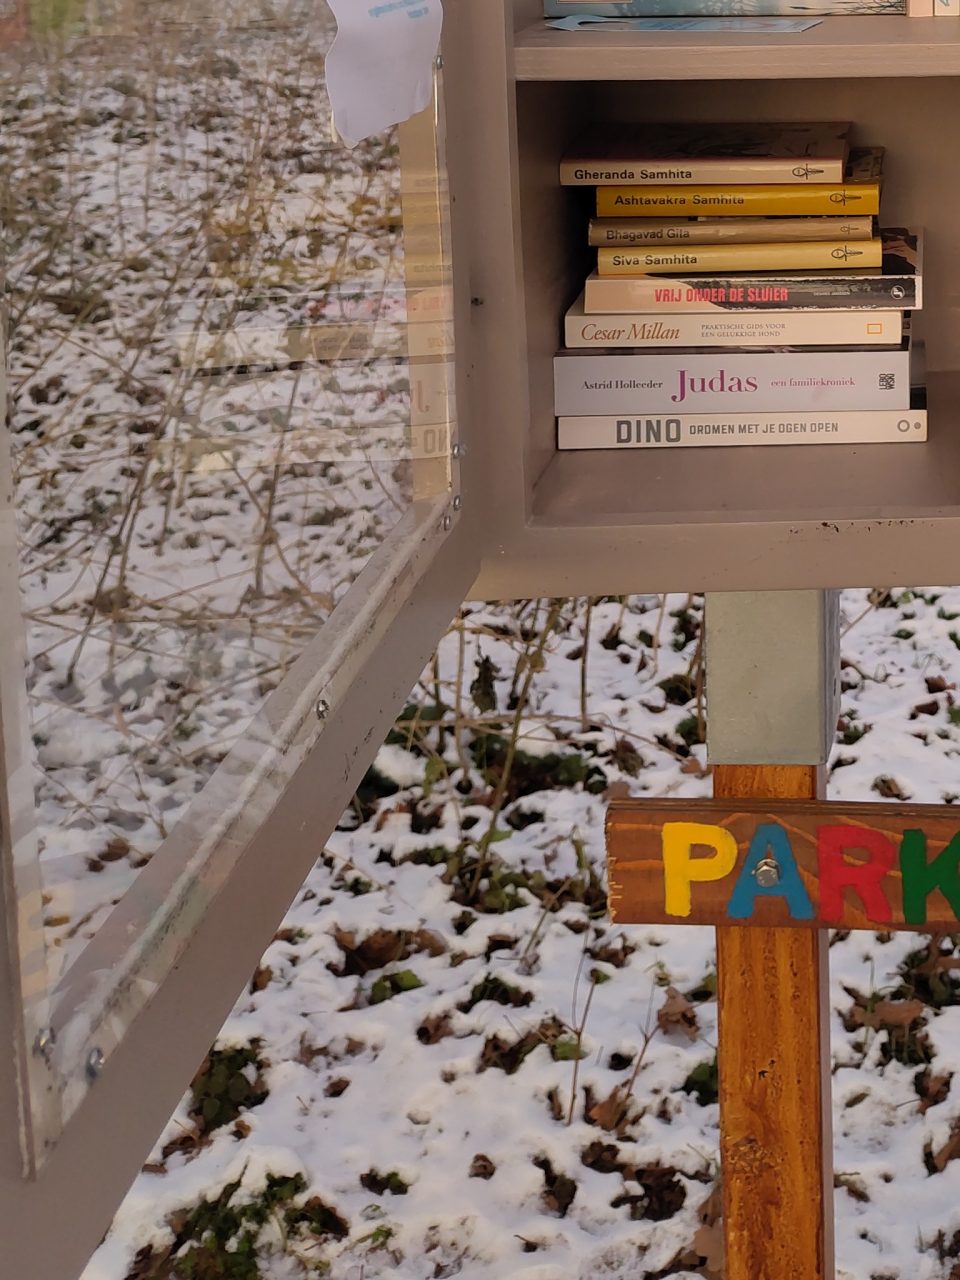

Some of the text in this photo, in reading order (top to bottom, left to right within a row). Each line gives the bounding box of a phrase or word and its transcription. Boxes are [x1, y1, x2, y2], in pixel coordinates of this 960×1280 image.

[574, 169, 692, 180] Gheranda Samhita
[614, 195, 744, 205] Ashtavakra Samhita
[606, 229, 663, 242] Bhagavad
[612, 255, 697, 266] Siva Samhita
[655, 287, 788, 303] VRIJ ONDER DE SLUIER
[581, 322, 680, 341] Cesar Millan
[582, 379, 663, 389] Astrid Holleeder
[670, 369, 758, 403] Judas
[789, 377, 856, 387] familiekroniek
[616, 418, 839, 444] DINO DROMEN MET JE OGEN OPEN
